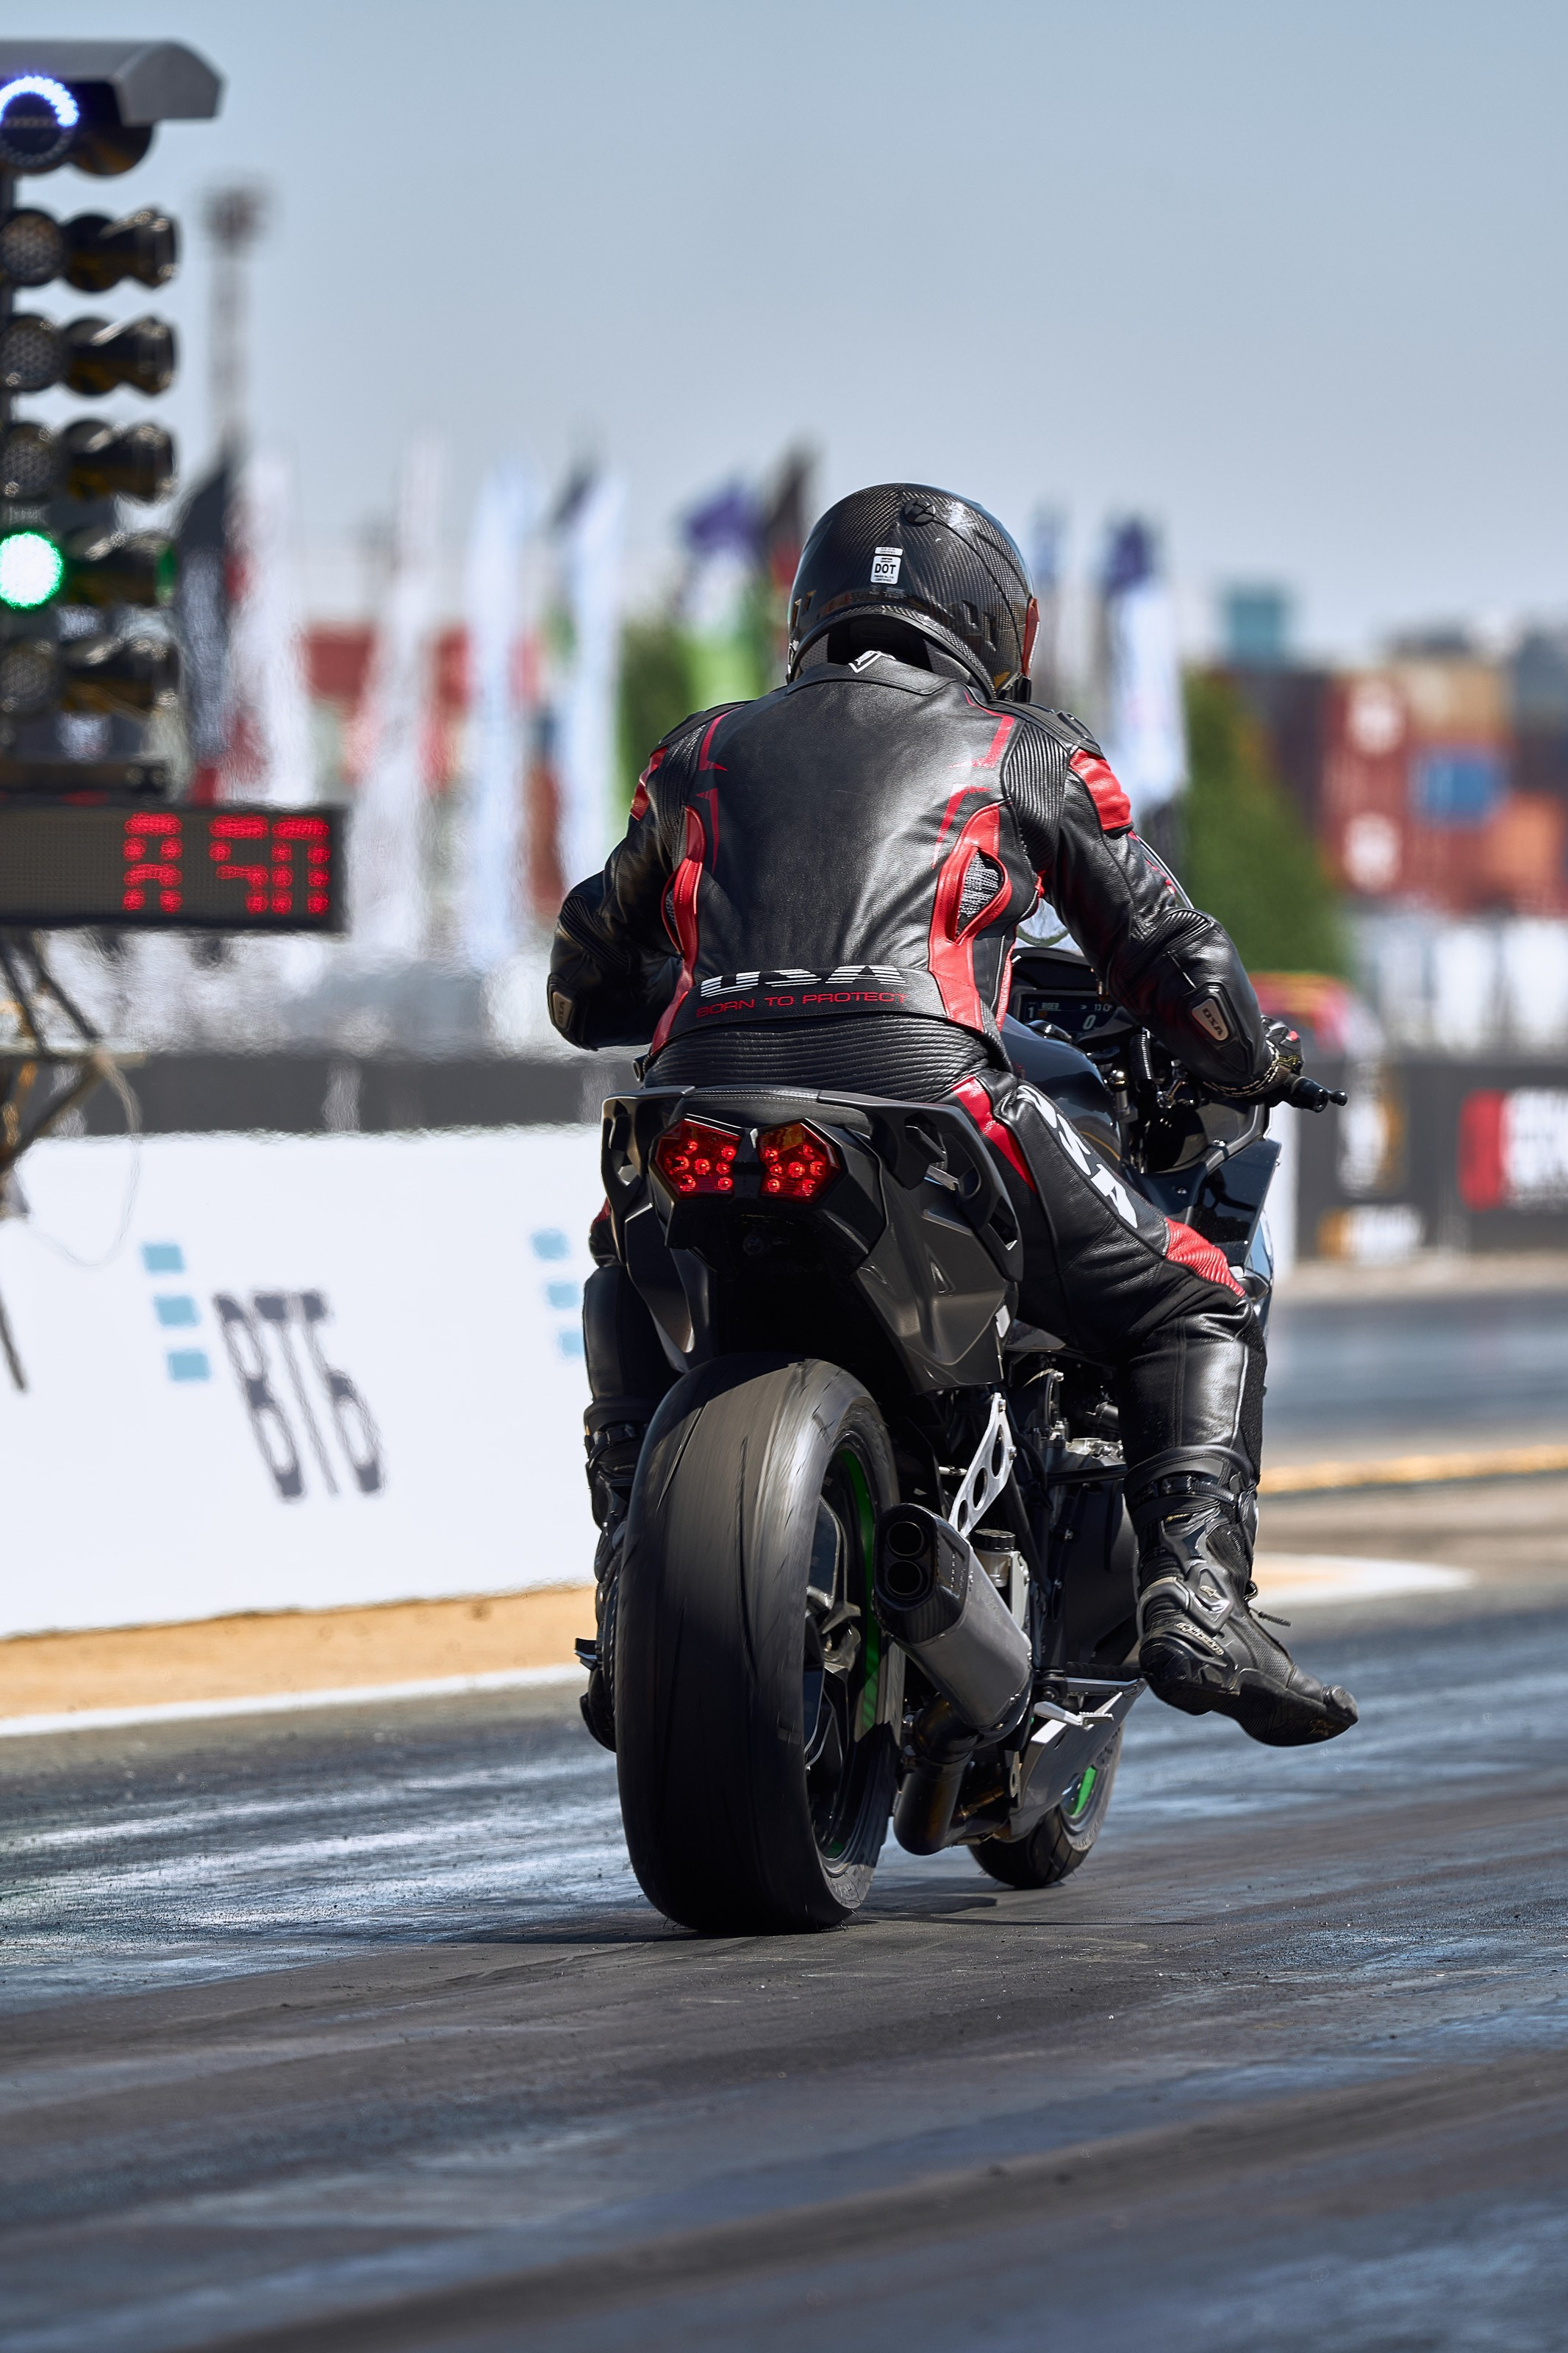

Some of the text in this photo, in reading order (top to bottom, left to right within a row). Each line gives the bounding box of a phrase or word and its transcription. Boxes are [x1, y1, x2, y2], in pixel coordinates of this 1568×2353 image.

[874, 563, 896, 574] DOT
[696, 992, 909, 1018] BORN TO PROTECT
